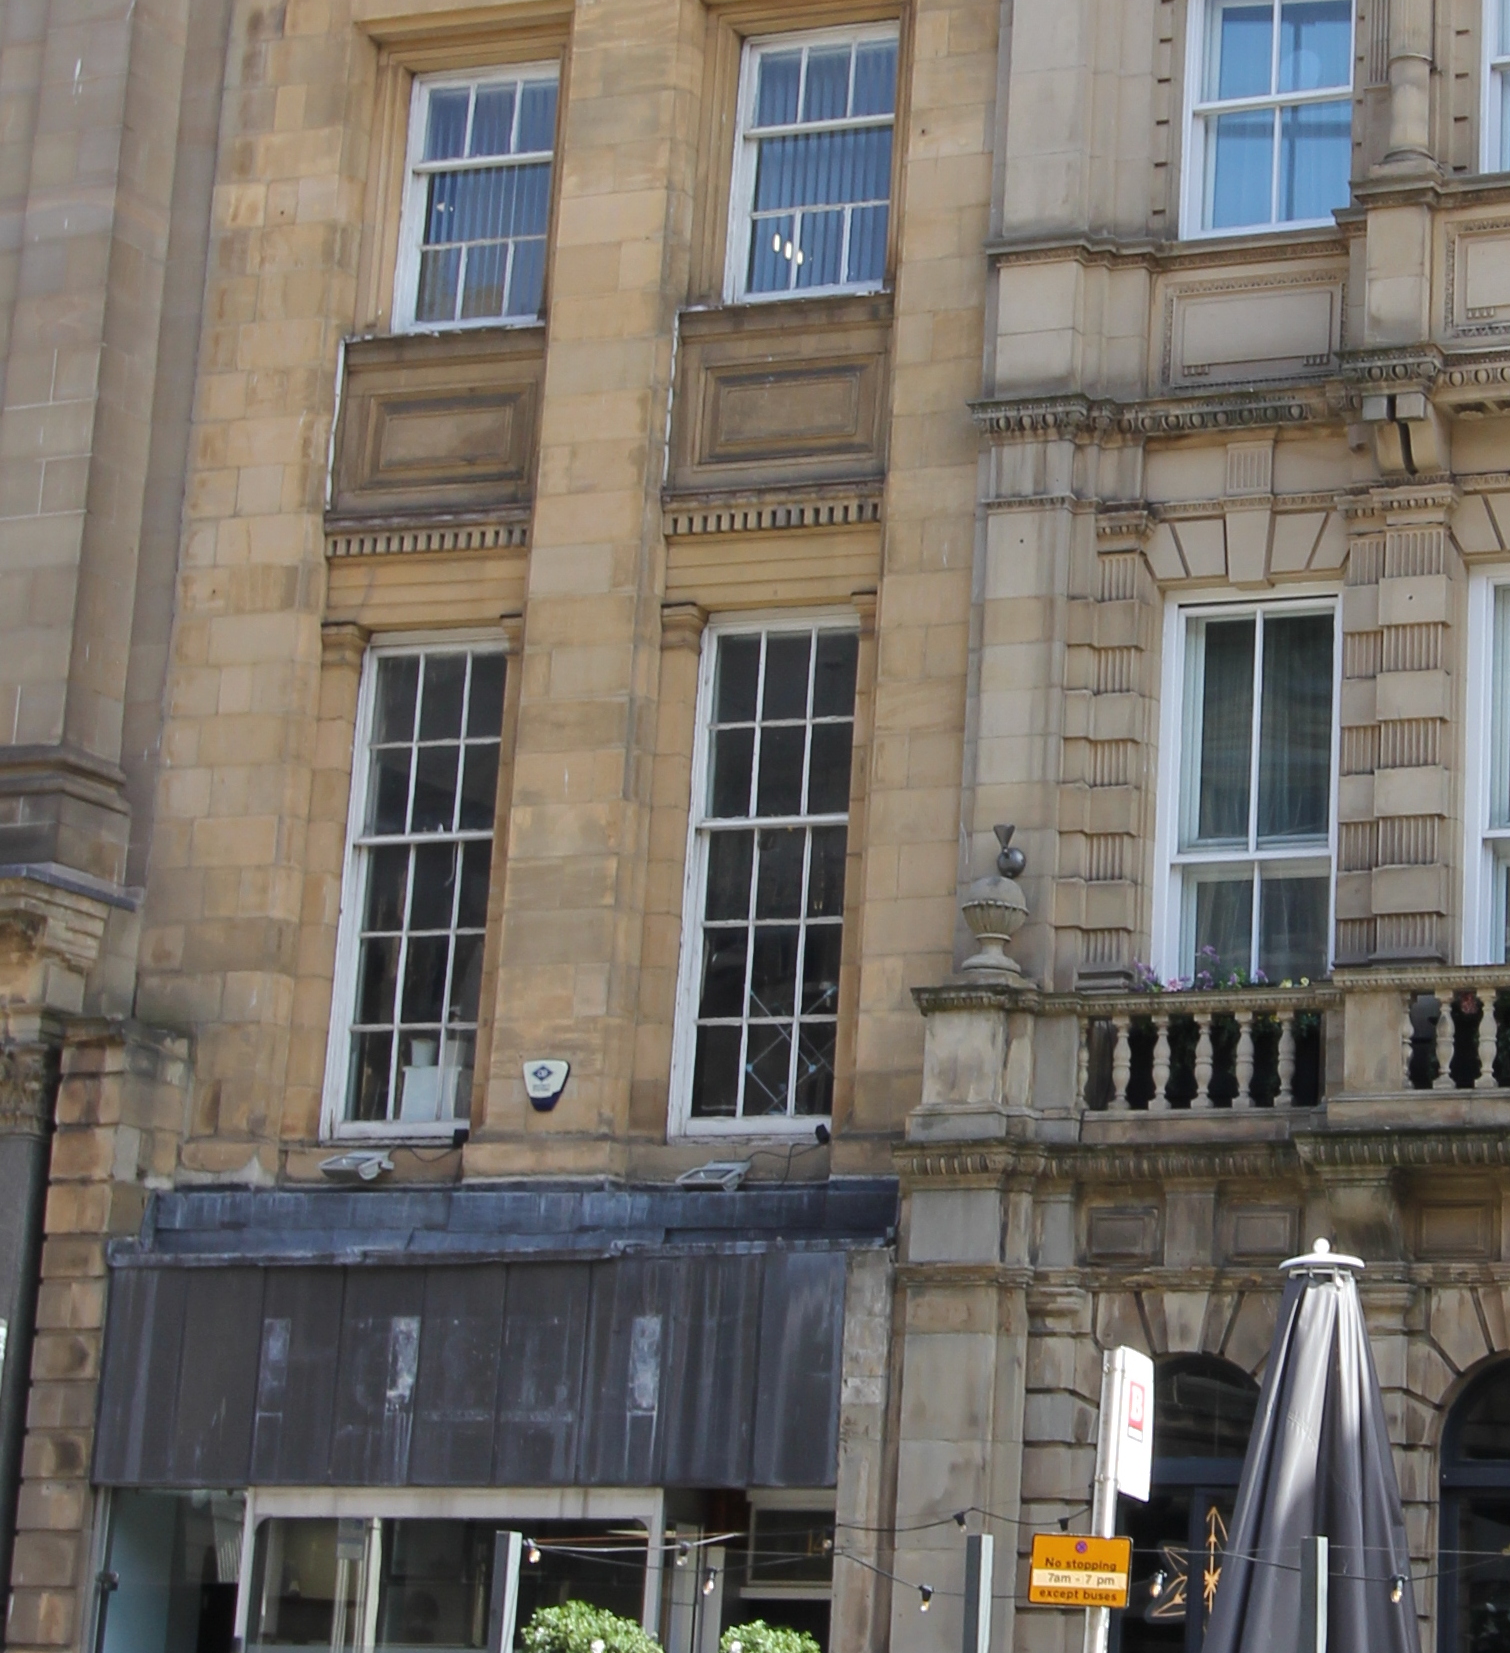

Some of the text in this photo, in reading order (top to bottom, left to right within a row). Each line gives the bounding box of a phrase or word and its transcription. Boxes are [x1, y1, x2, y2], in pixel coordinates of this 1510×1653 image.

[1045, 1557, 1117, 1572] No stopping
[1047, 1573, 1071, 1583] 7am
[1085, 1574, 1092, 1584] 7
[1096, 1576, 1115, 1586] pm
[1039, 1589, 1117, 1601] except buses
